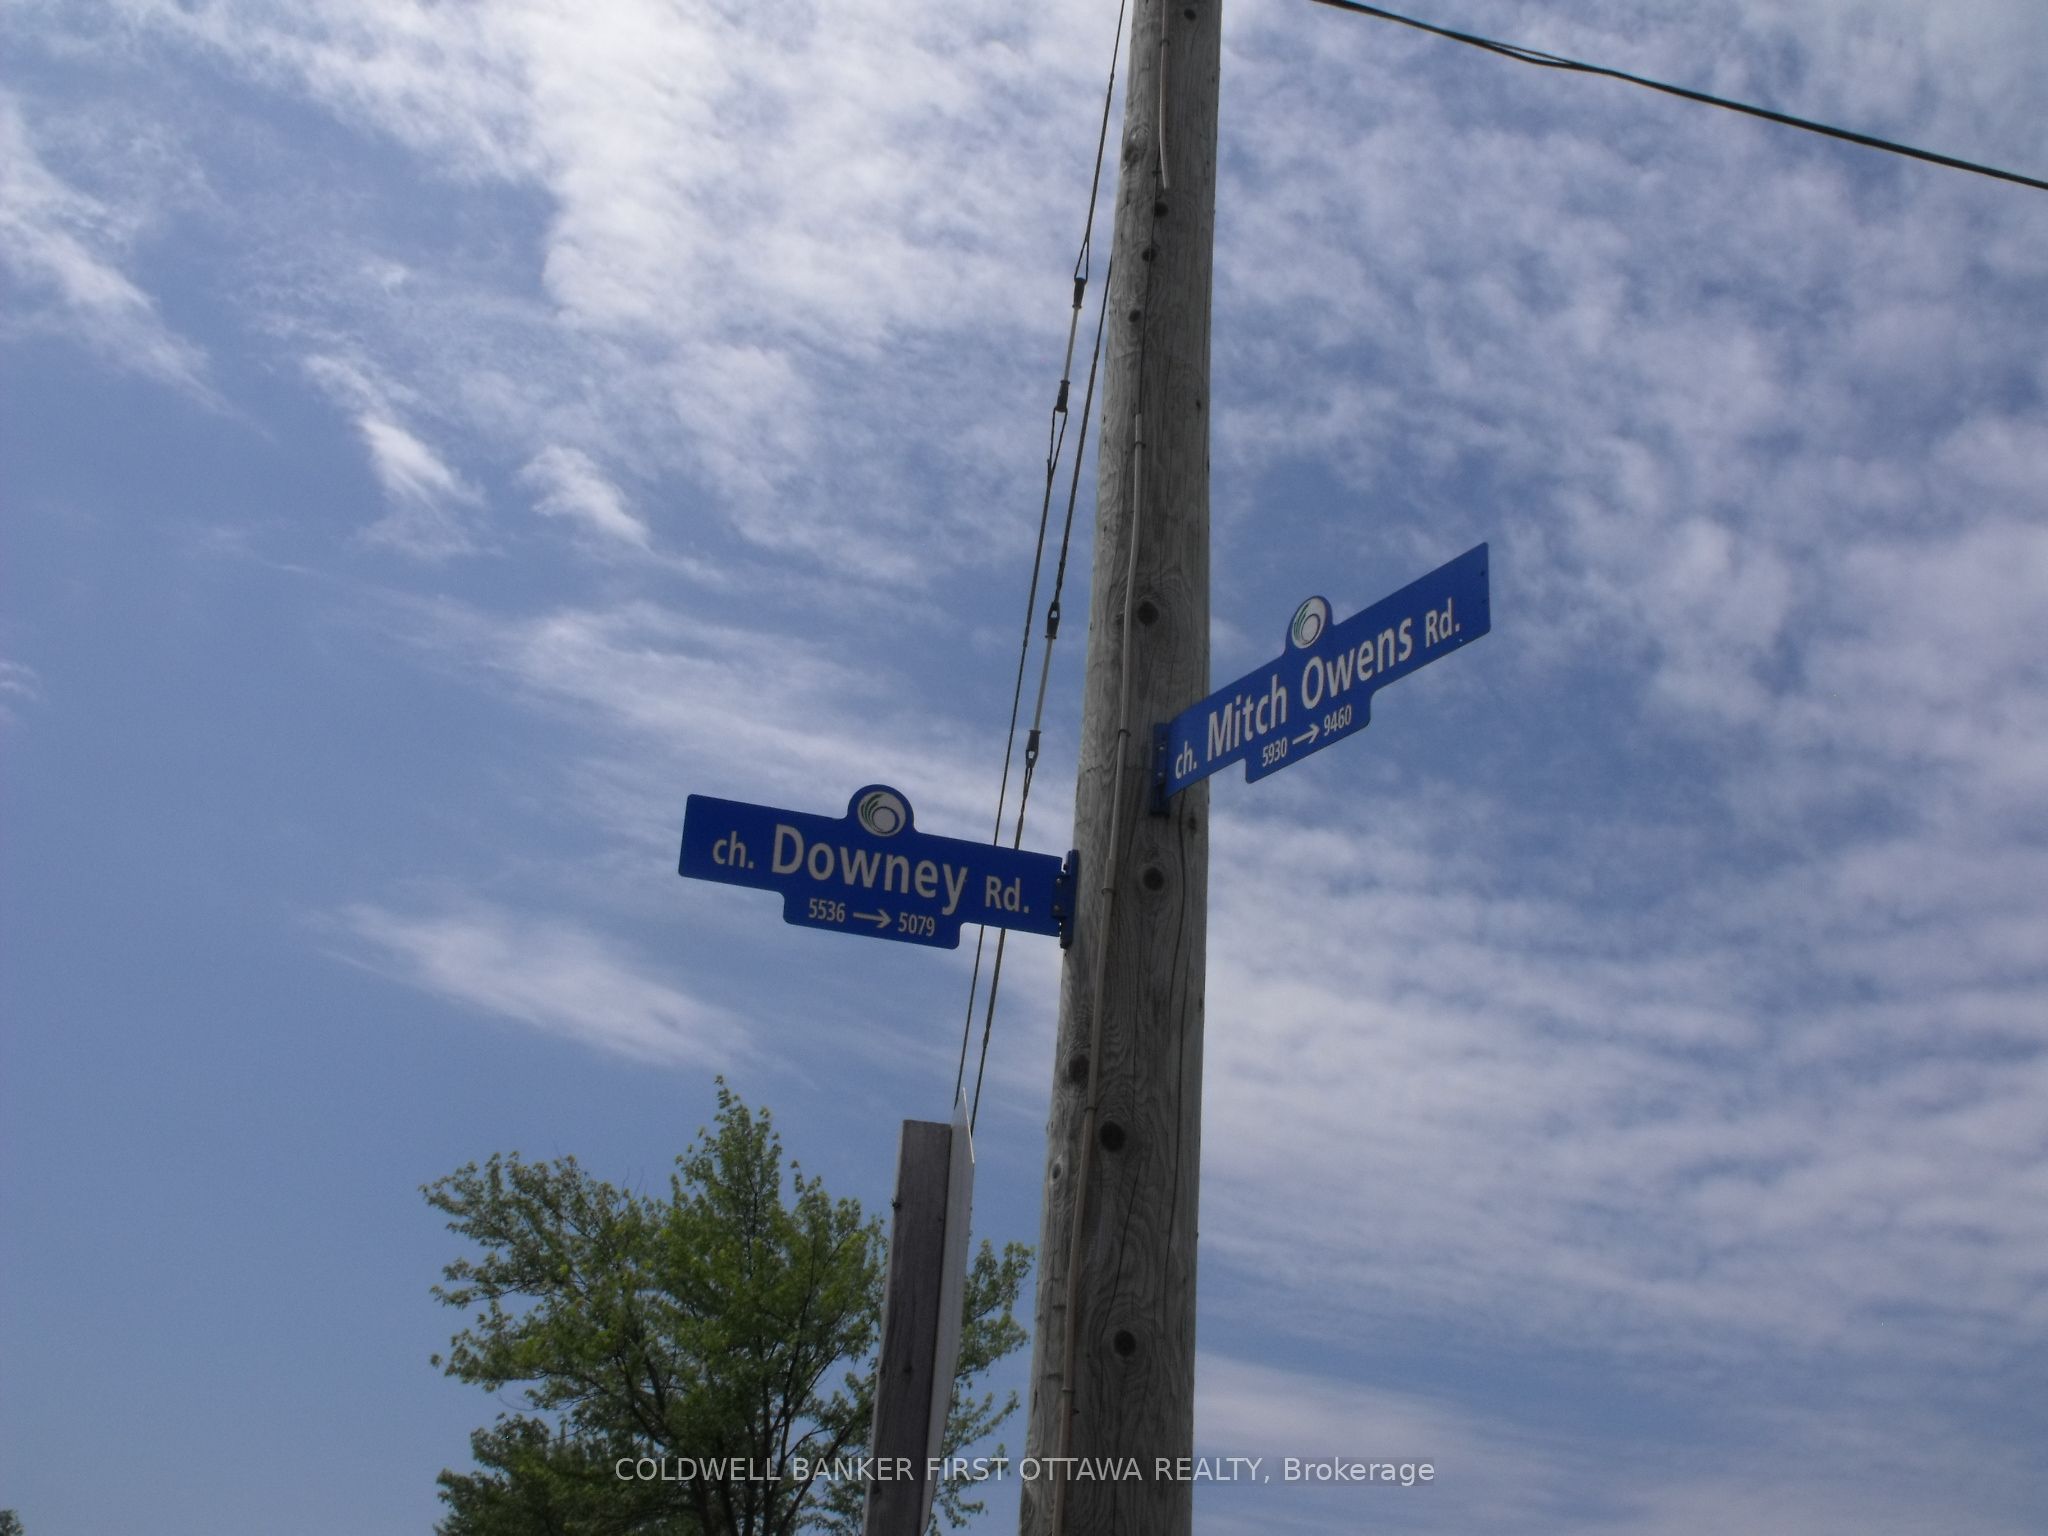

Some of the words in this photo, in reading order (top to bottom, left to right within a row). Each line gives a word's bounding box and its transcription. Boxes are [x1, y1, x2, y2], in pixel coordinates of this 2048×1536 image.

[1175, 741, 1197, 779] ch.
[1207, 674, 1287, 763] Mitch
[1301, 617, 1412, 710] Owens
[1425, 597, 1460, 648] Rd.
[1262, 737, 1287, 768] 5930
[1323, 704, 1352, 737] 9460
[712, 831, 754, 869] ch.
[772, 823, 968, 915] Downey
[985, 876, 1030, 914] Rd.
[808, 898, 846, 923] 5536
[898, 912, 935, 937] 5079
